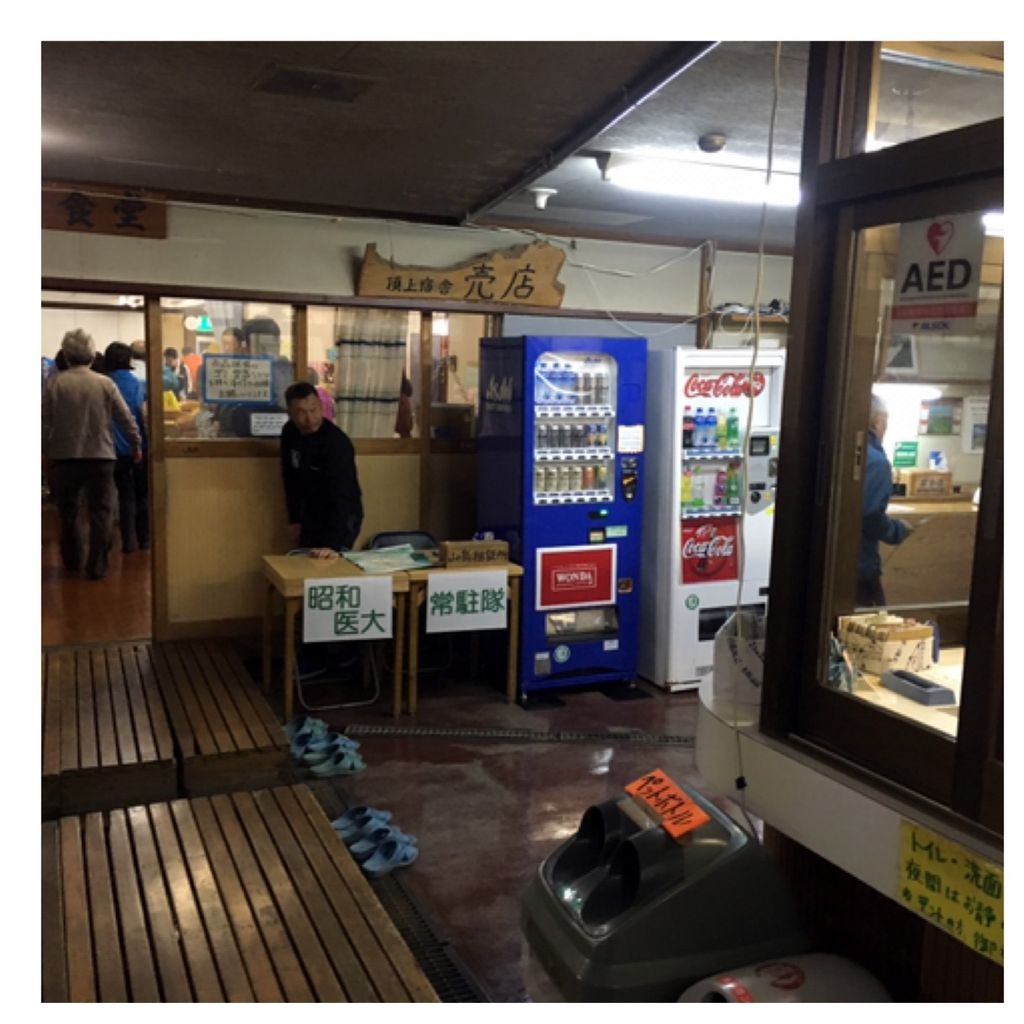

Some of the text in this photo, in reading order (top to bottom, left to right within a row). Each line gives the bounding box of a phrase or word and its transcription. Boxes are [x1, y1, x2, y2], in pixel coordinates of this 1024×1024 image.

[57, 189, 146, 231] 食堂
[463, 263, 536, 299] 売店
[901, 259, 972, 293] AED
[683, 534, 735, 559] Coca-Cola
[307, 584, 361, 611] 昭和
[430, 588, 505, 616] 常駐隊
[334, 609, 386, 635] 医大
